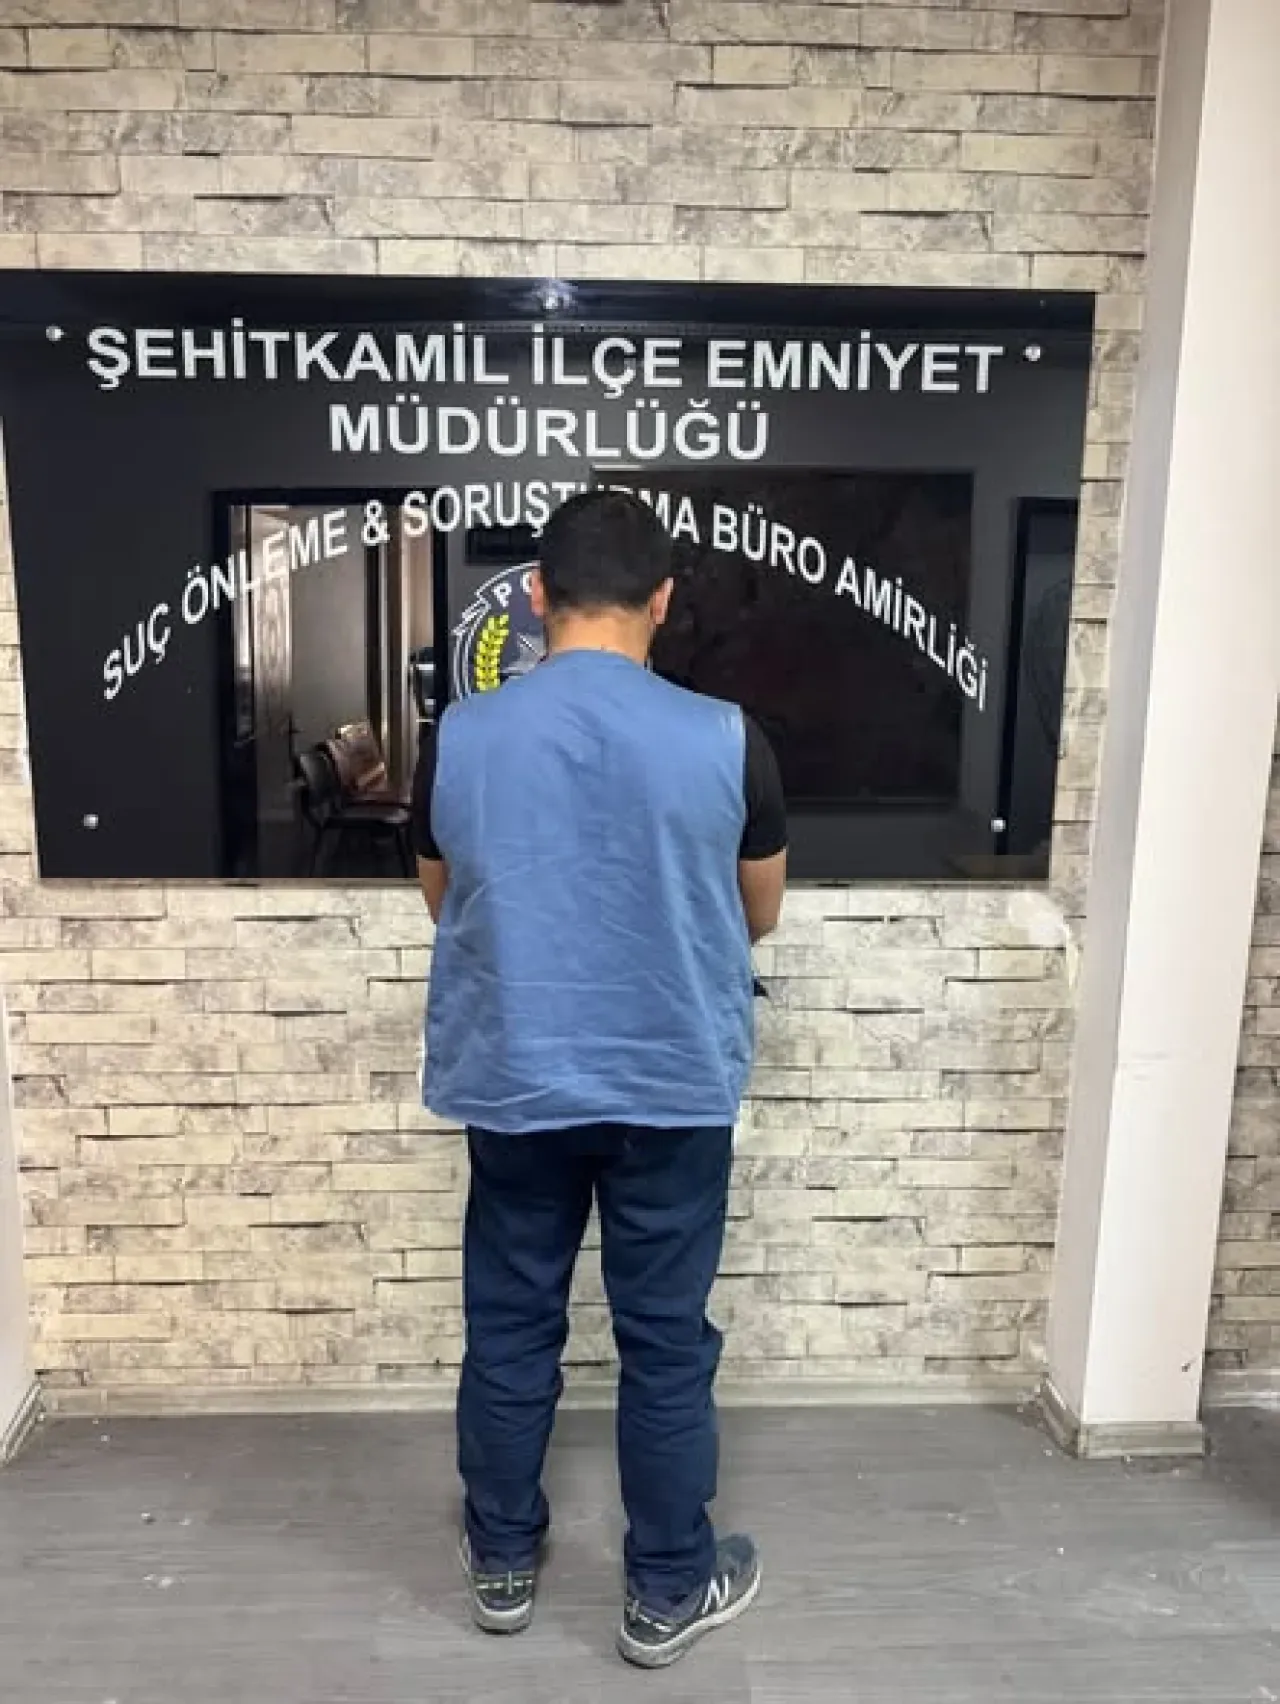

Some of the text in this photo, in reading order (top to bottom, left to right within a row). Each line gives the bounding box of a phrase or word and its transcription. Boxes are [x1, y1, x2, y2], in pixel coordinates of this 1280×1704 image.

[87, 317, 1004, 399] ŞEHİTKAMİL İLÇE EMNİYET
[331, 395, 770, 460] MÜDÜRLÜĞÜ
[103, 603, 171, 700] SUÇ
[181, 509, 348, 624] ÖNLEME
[361, 500, 389, 547] &
[712, 504, 827, 584] BÜRO
[834, 556, 988, 711] AMİRLİĞİ
